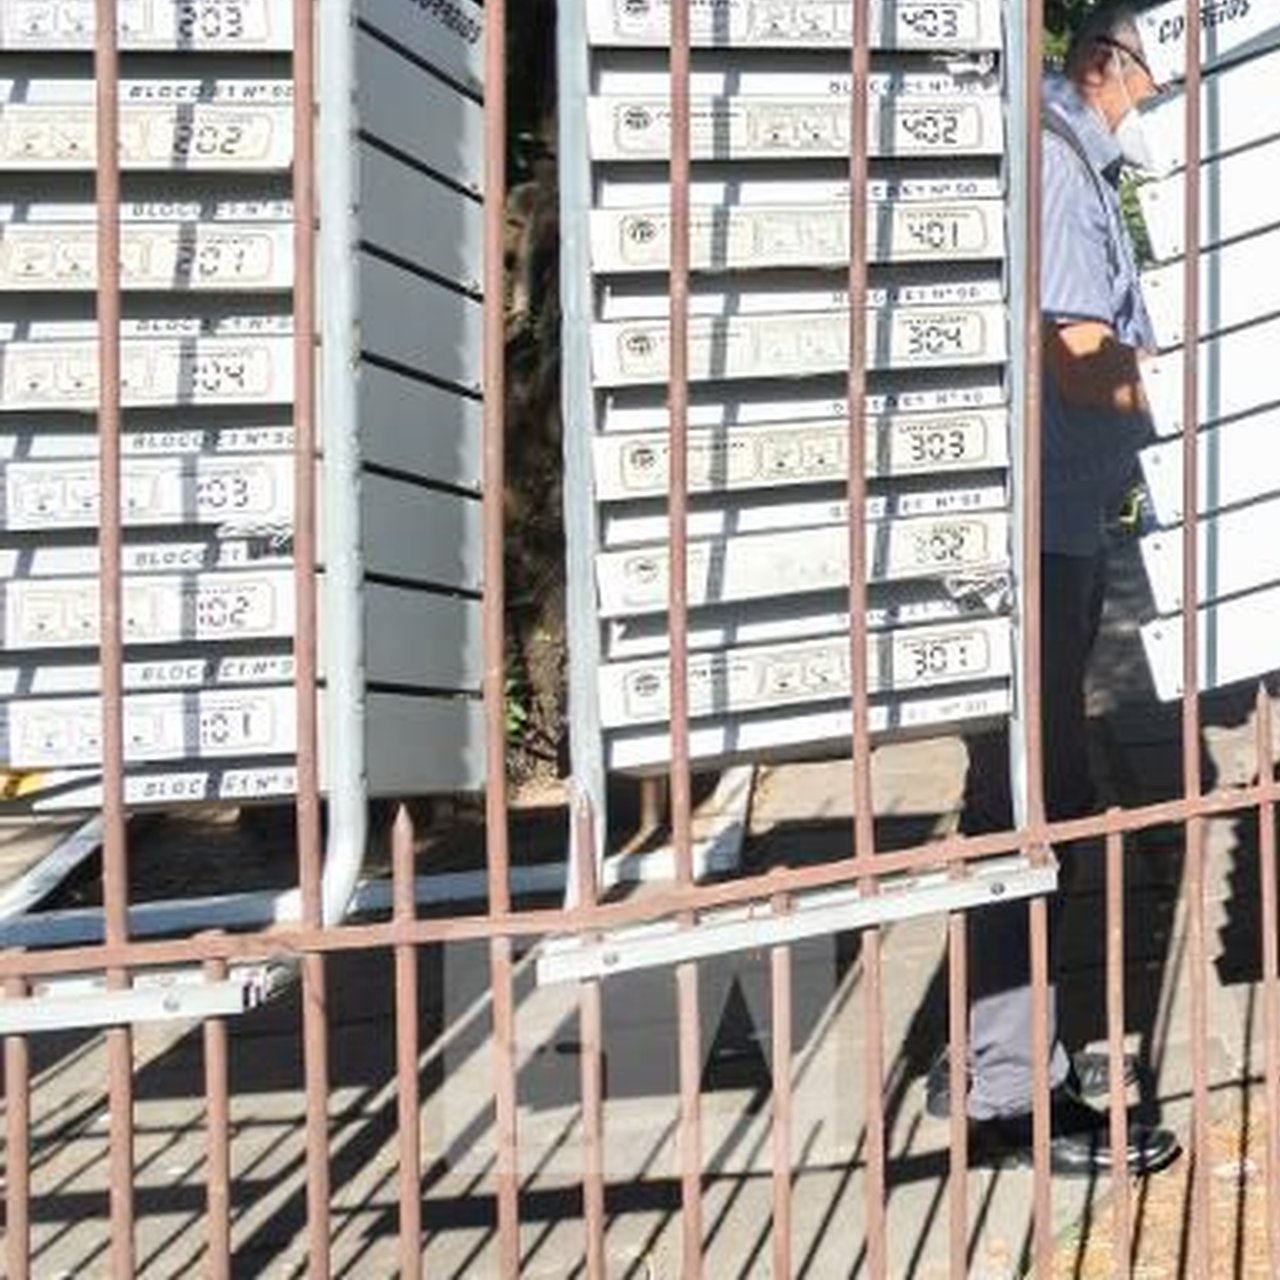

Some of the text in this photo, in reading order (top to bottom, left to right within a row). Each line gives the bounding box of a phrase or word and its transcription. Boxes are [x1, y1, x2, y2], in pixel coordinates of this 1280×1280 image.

[178, 6, 243, 38] 203
[901, 8, 958, 38] 403
[173, 124, 243, 155] 202
[902, 116, 958, 145] 402
[907, 221, 958, 248] 401
[175, 244, 245, 276] 201
[908, 325, 963, 355] 304
[911, 431, 965, 461] 303
[913, 534, 965, 563] 302
[912, 646, 968, 677] 301
[201, 712, 251, 744] 101
